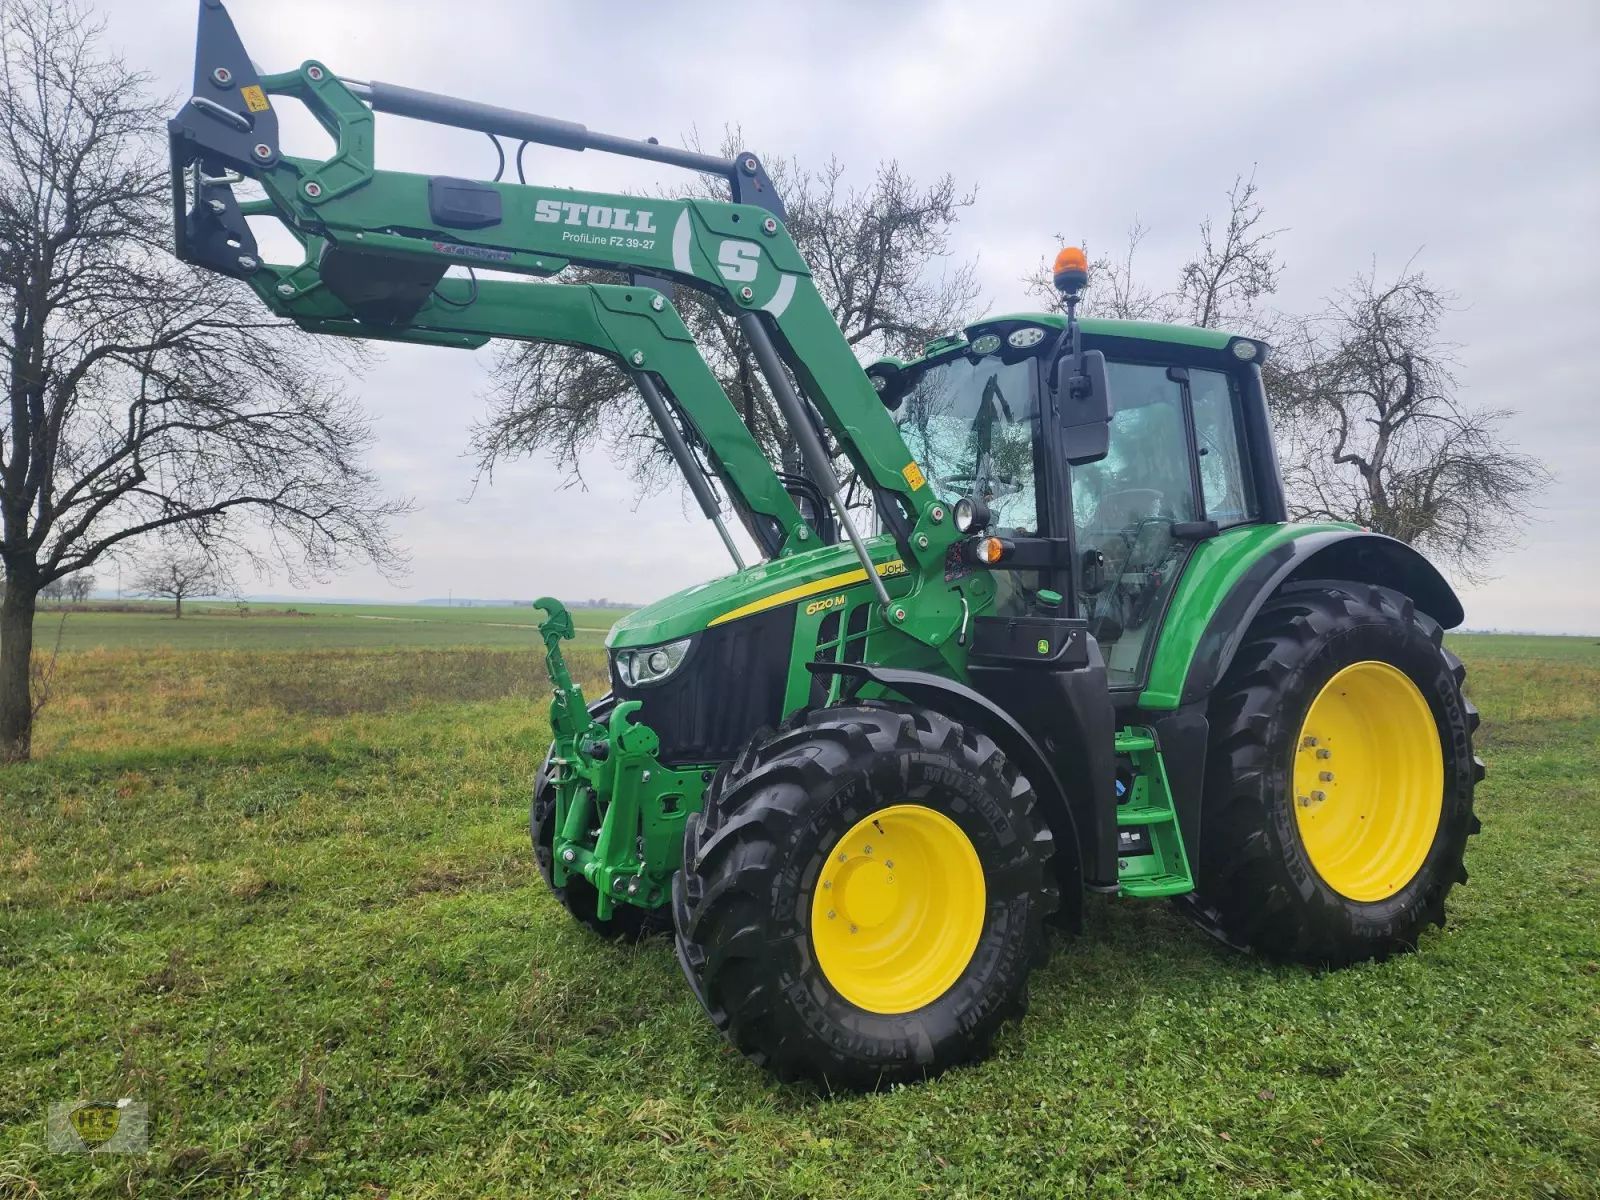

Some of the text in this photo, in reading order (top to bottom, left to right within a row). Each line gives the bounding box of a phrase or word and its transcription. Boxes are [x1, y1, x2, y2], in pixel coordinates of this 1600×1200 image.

[534, 199, 657, 234] STOLL
[562, 231, 656, 250] ProfiLine FZ 39-27
[718, 239, 761, 283] S
[806, 594, 847, 616] 6120 M
